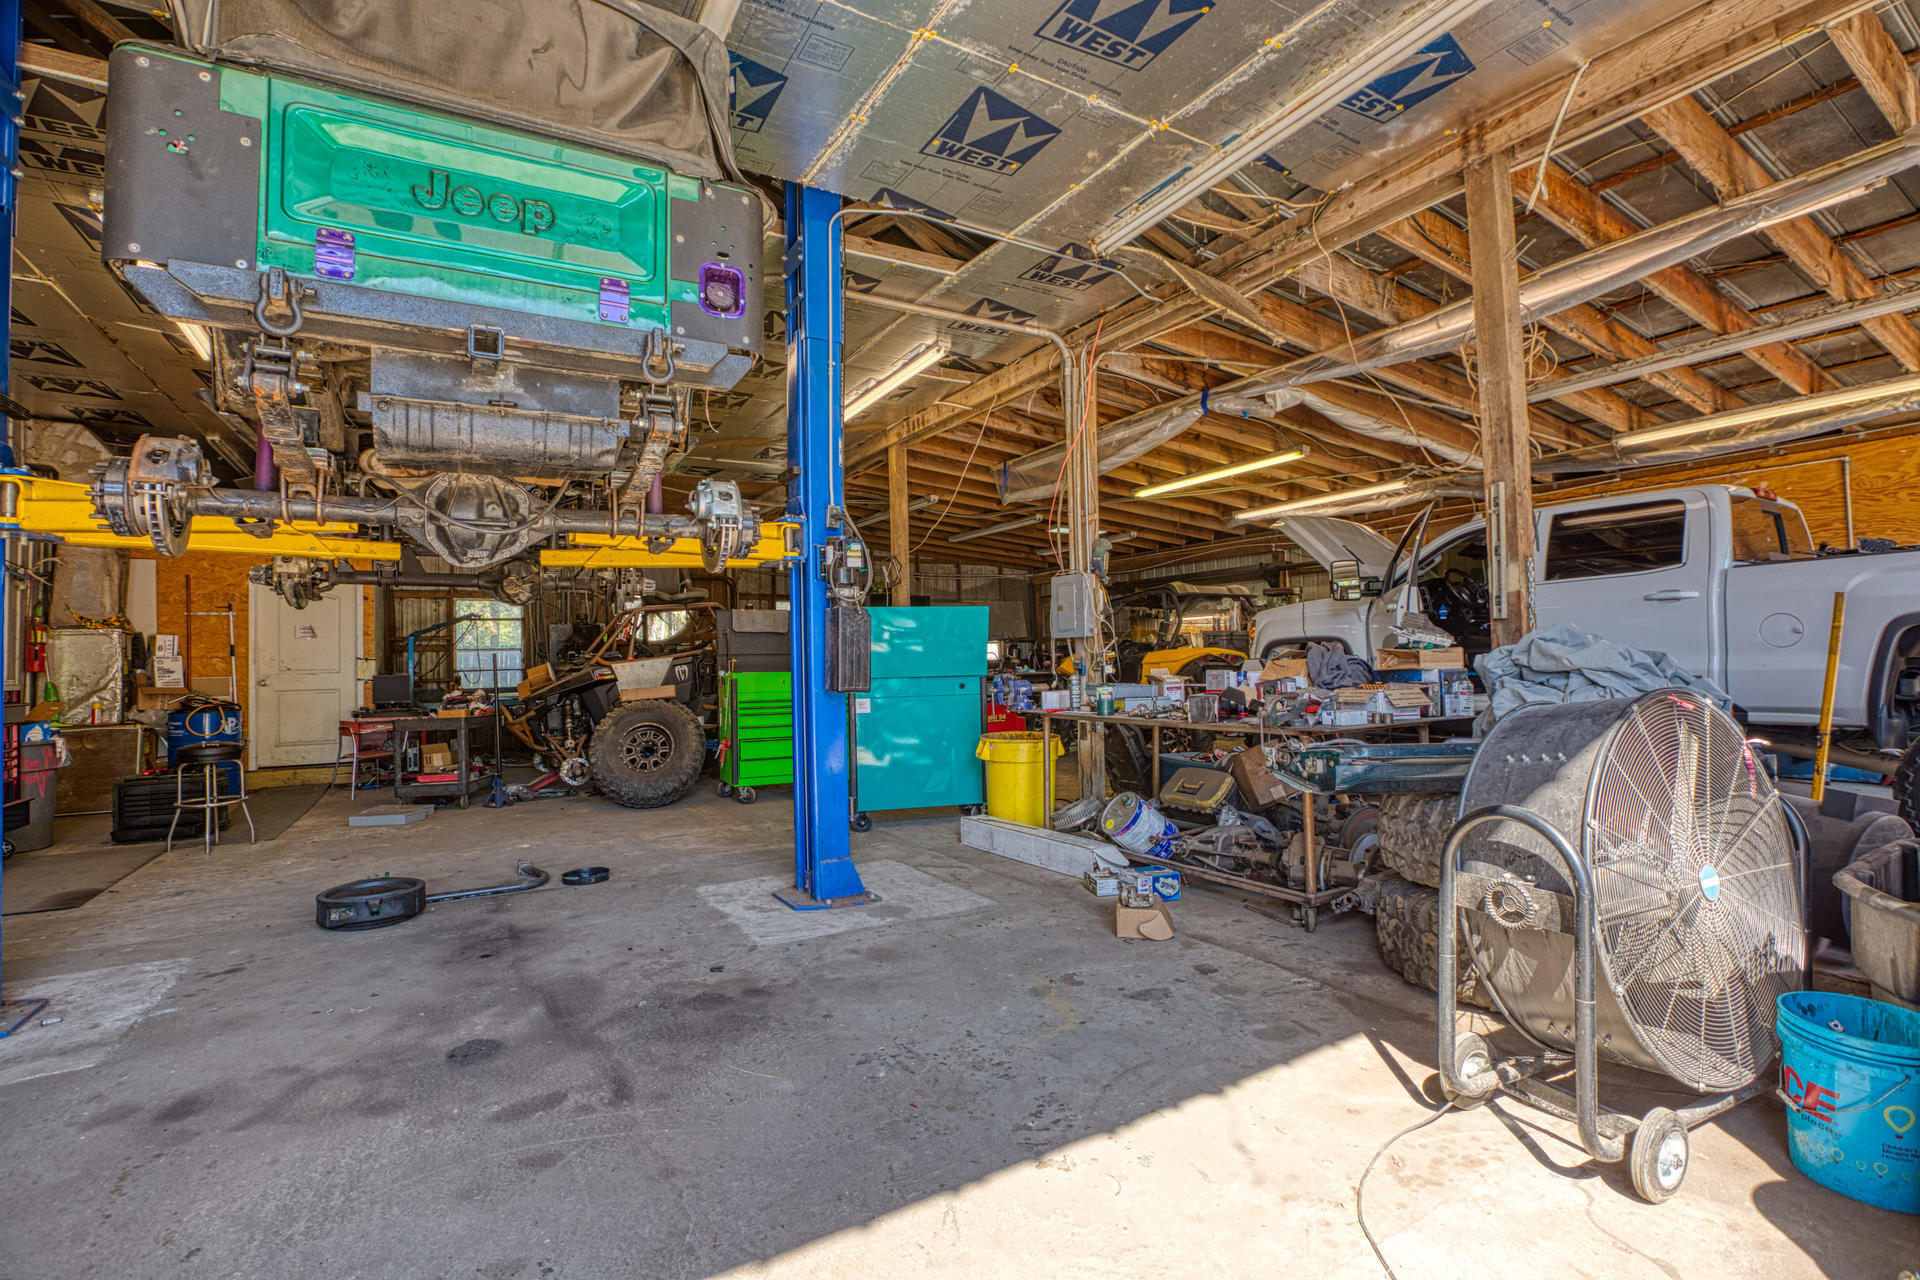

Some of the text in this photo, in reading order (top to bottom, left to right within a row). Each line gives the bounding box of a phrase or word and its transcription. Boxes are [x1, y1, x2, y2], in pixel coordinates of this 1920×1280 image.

[1053, 16, 1147, 64] WEST
[1342, 89, 1396, 117] EST
[934, 140, 1013, 171] WEST
[411, 169, 556, 235] Jeep
[1029, 271, 1088, 289] WEST
[1785, 1064, 1841, 1124] CE
